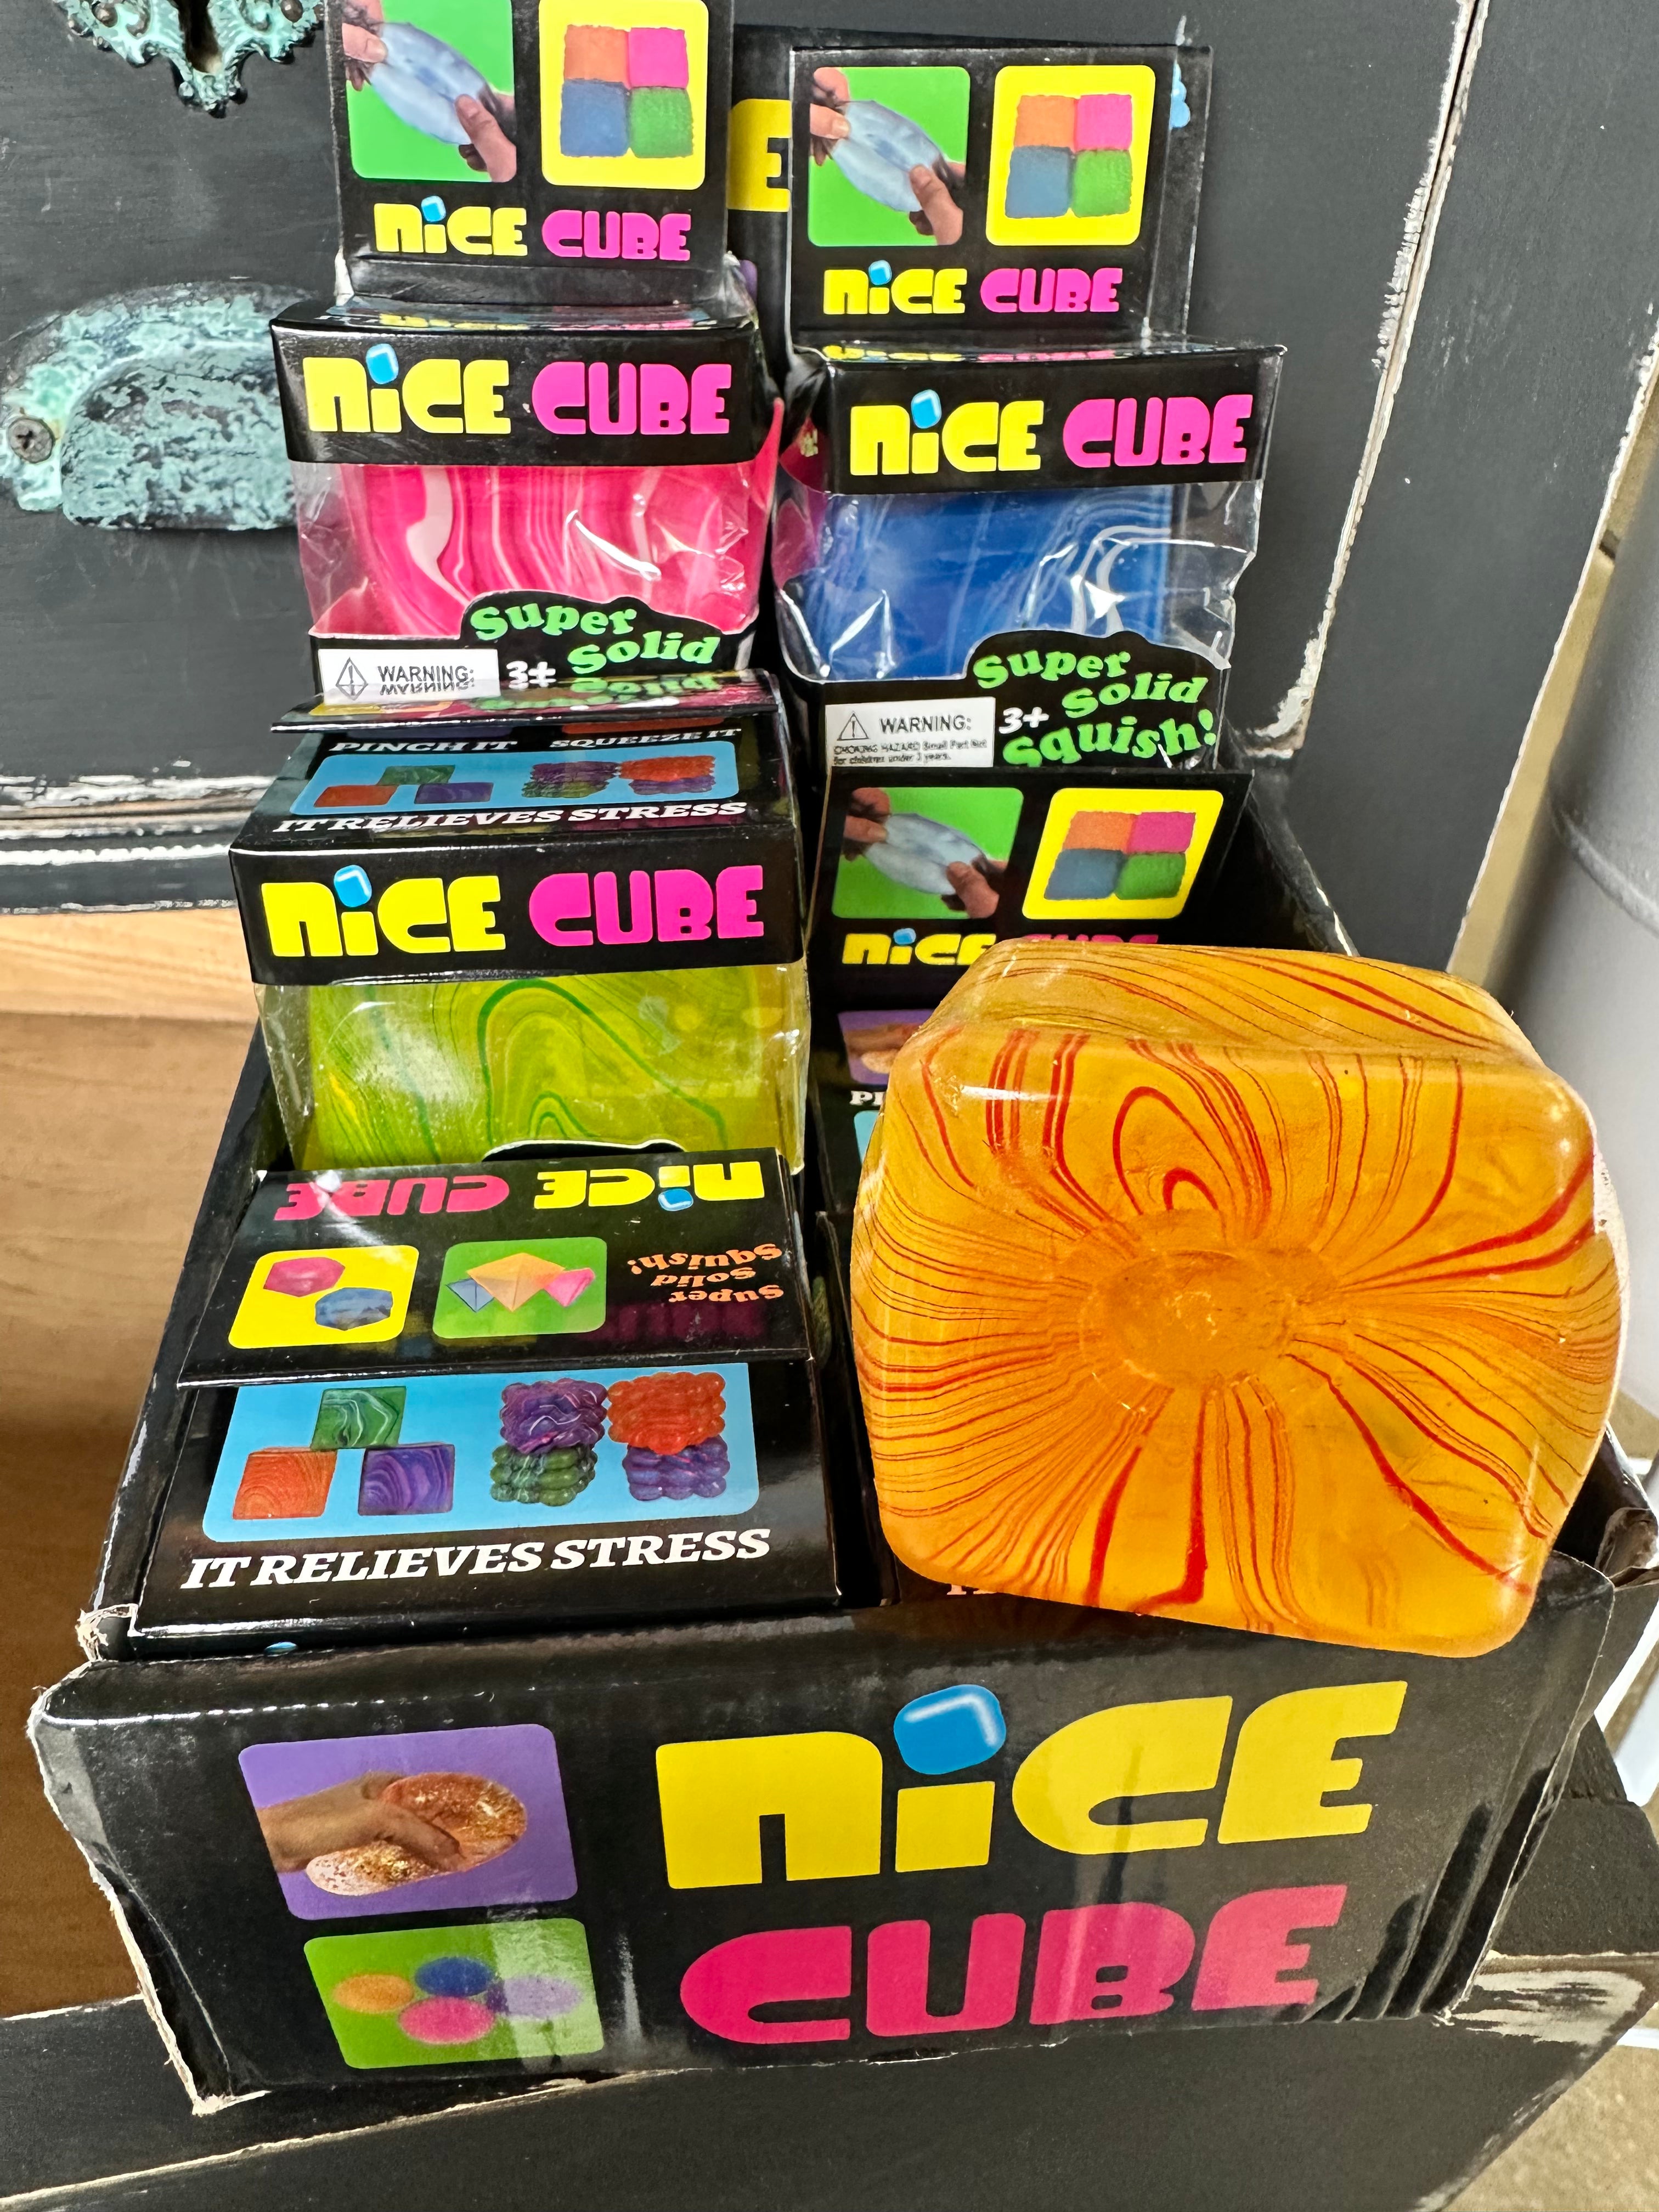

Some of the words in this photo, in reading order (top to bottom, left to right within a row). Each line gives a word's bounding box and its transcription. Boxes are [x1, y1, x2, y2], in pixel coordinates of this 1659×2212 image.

[541, 210, 691, 261] CUBE
[980, 268, 1122, 313] CUBE
[532, 362, 732, 435] CUBE
[1063, 394, 1253, 468] CUBE
[470, 603, 637, 641] Super
[377, 665, 474, 682] WARNING:
[567, 631, 720, 674] Solid
[973, 650, 1131, 689] Super
[1062, 672, 1208, 718] Solid
[549, 732, 702, 748] SQUEEZE
[706, 728, 742, 738] IT
[879, 714, 971, 734] WARNING:
[998, 707, 1049, 734] 3+
[329, 742, 465, 752] PINCH
[469, 741, 518, 750] IT
[273, 819, 322, 832] IT
[327, 810, 564, 831] RELIEVES
[567, 802, 747, 823] STRESS
[529, 865, 764, 947] CUBE
[274, 1175, 510, 1221] CUBE
[180, 1556, 252, 1589] IT
[250, 1542, 545, 1586] RELIEVES
[550, 1528, 771, 1570] STRESS
[680, 1884, 1347, 2045] CUBE
